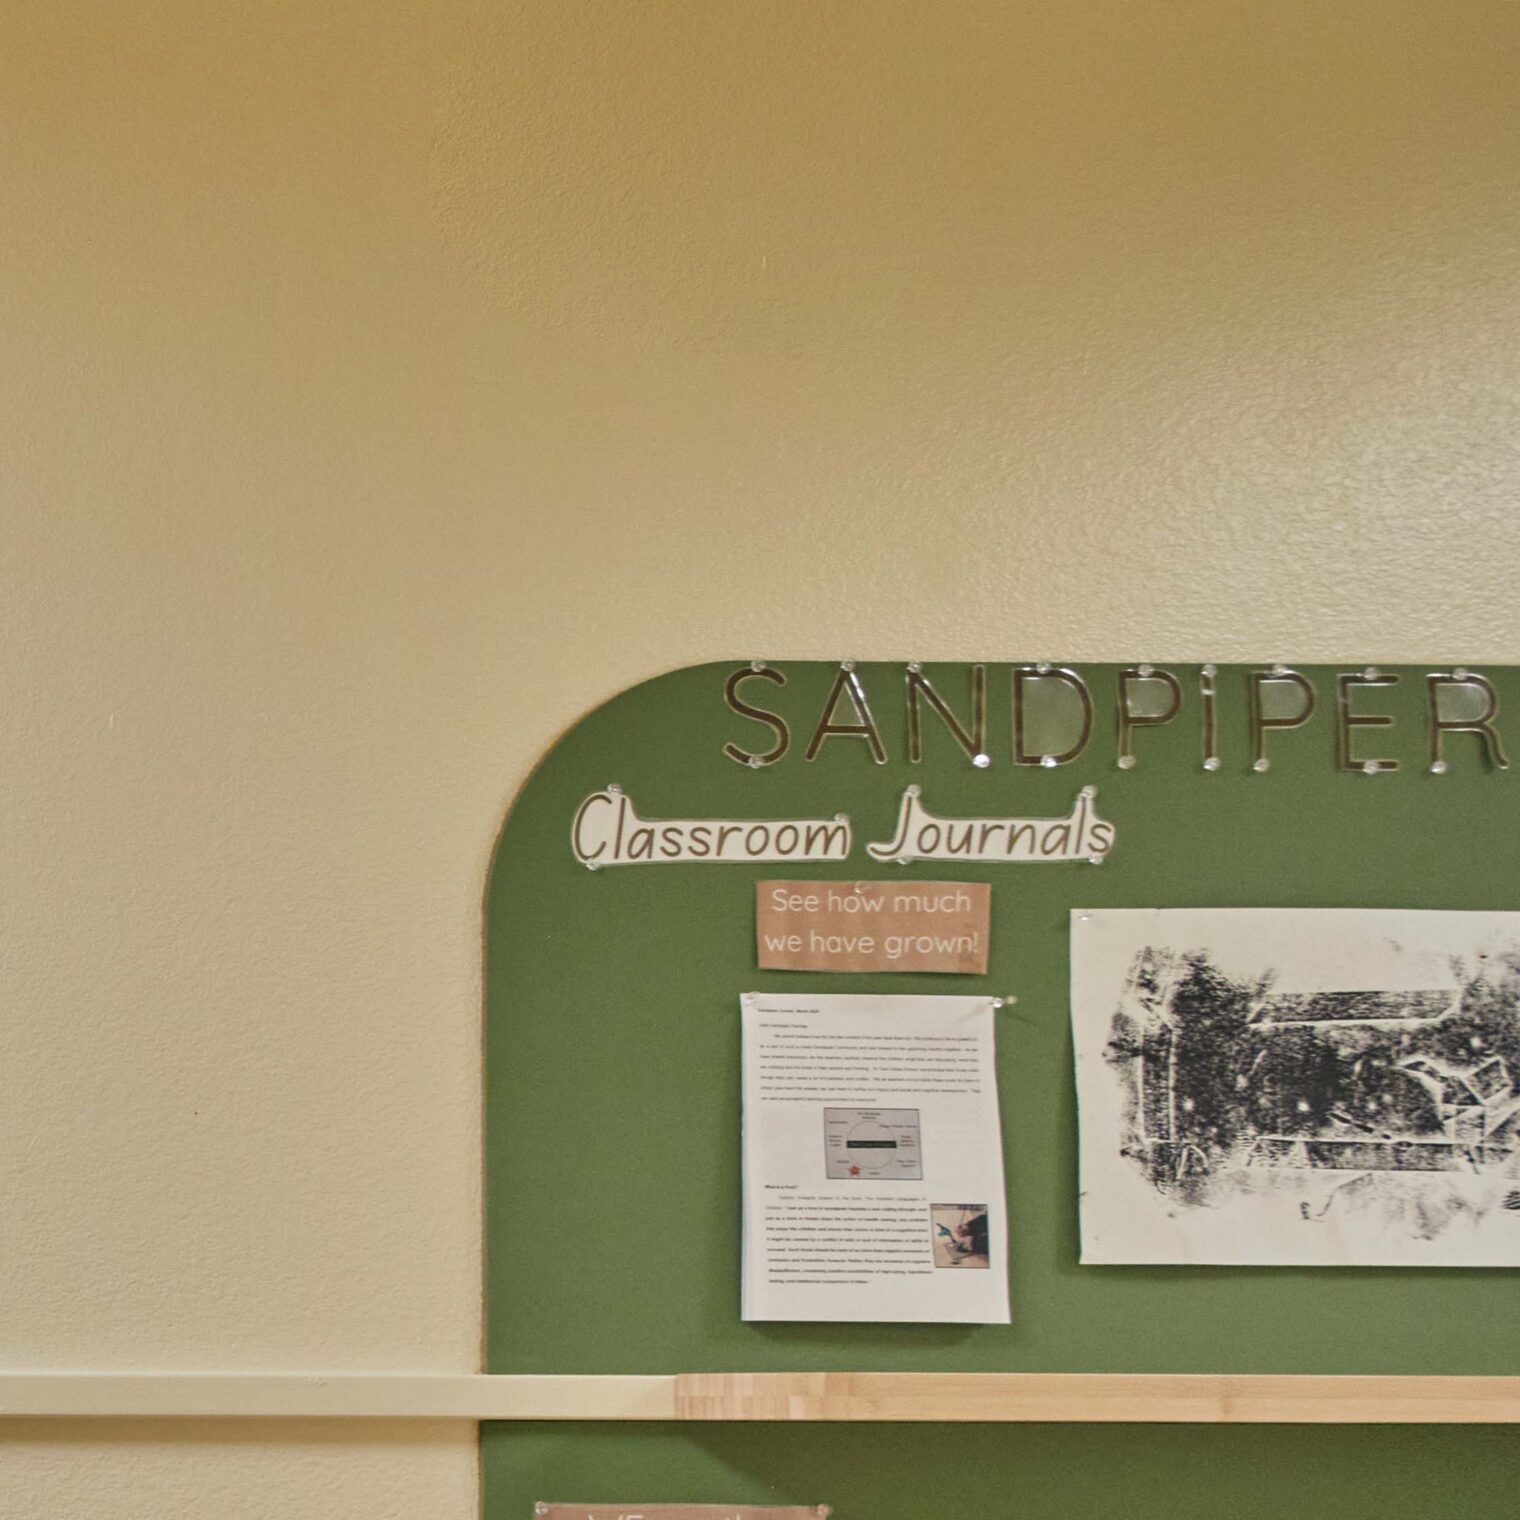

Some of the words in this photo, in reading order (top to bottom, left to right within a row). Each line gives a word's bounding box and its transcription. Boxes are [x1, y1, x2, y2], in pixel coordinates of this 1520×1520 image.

[723, 664, 1508, 772] SANDPIPER
[575, 793, 849, 862] Classroom
[870, 793, 1113, 862] Journals
[771, 887, 820, 914] See
[828, 887, 885, 914] how
[892, 887, 972, 914] much
[764, 934, 802, 955] we
[809, 928, 878, 955] have
[885, 930, 980, 962] grown!
